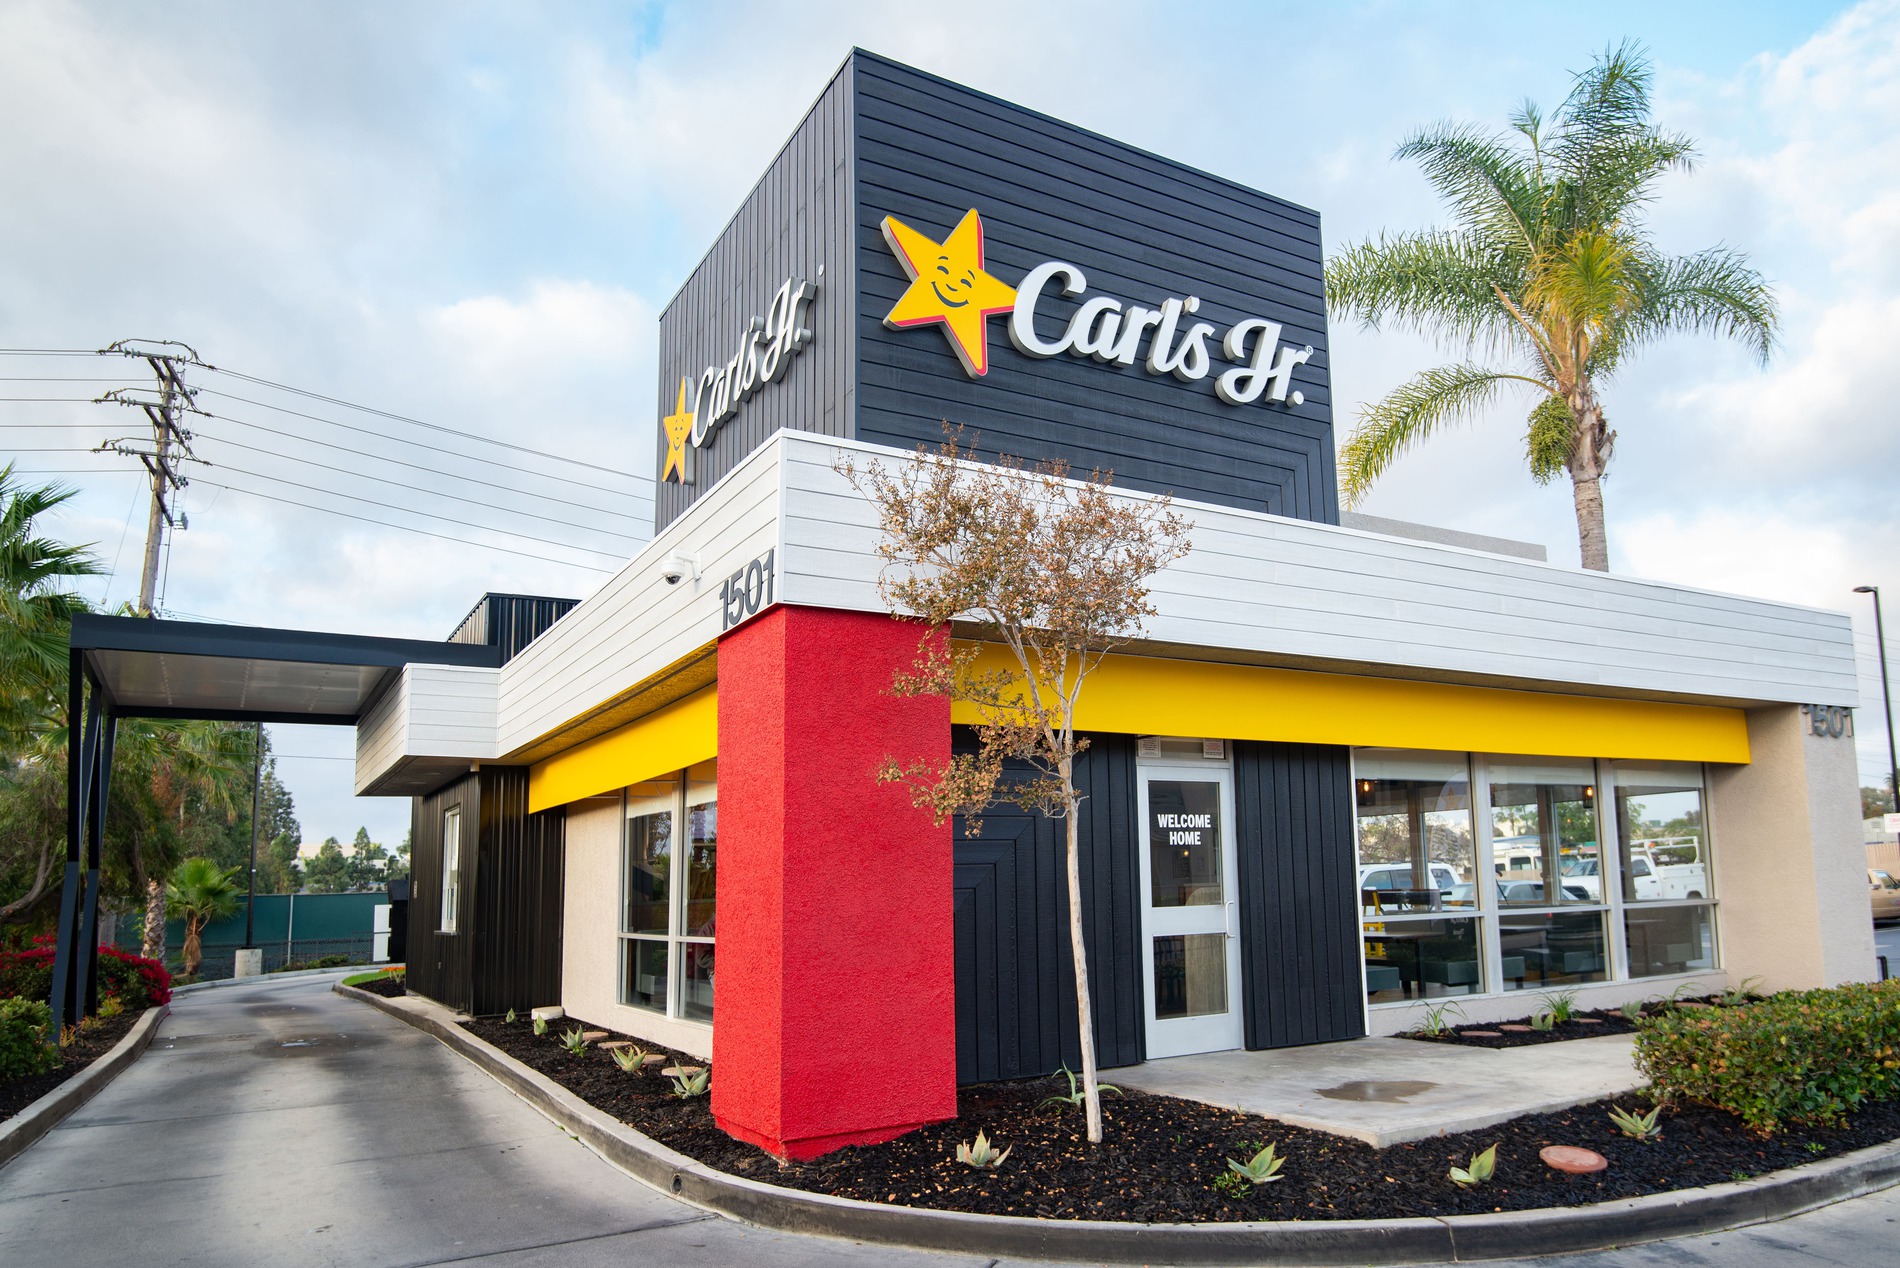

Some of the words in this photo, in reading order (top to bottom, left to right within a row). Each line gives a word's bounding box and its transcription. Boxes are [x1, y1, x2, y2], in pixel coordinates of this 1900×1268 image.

[691, 315, 767, 449] Carl's
[760, 276, 817, 384] Jr.
[1008, 261, 1216, 382] Carl's
[1214, 318, 1311, 407] Jr.
[719, 548, 775, 631] 1501
[1802, 704, 1854, 738] 1501
[1157, 813, 1211, 828] WELCOME
[1169, 831, 1201, 845] HOME
